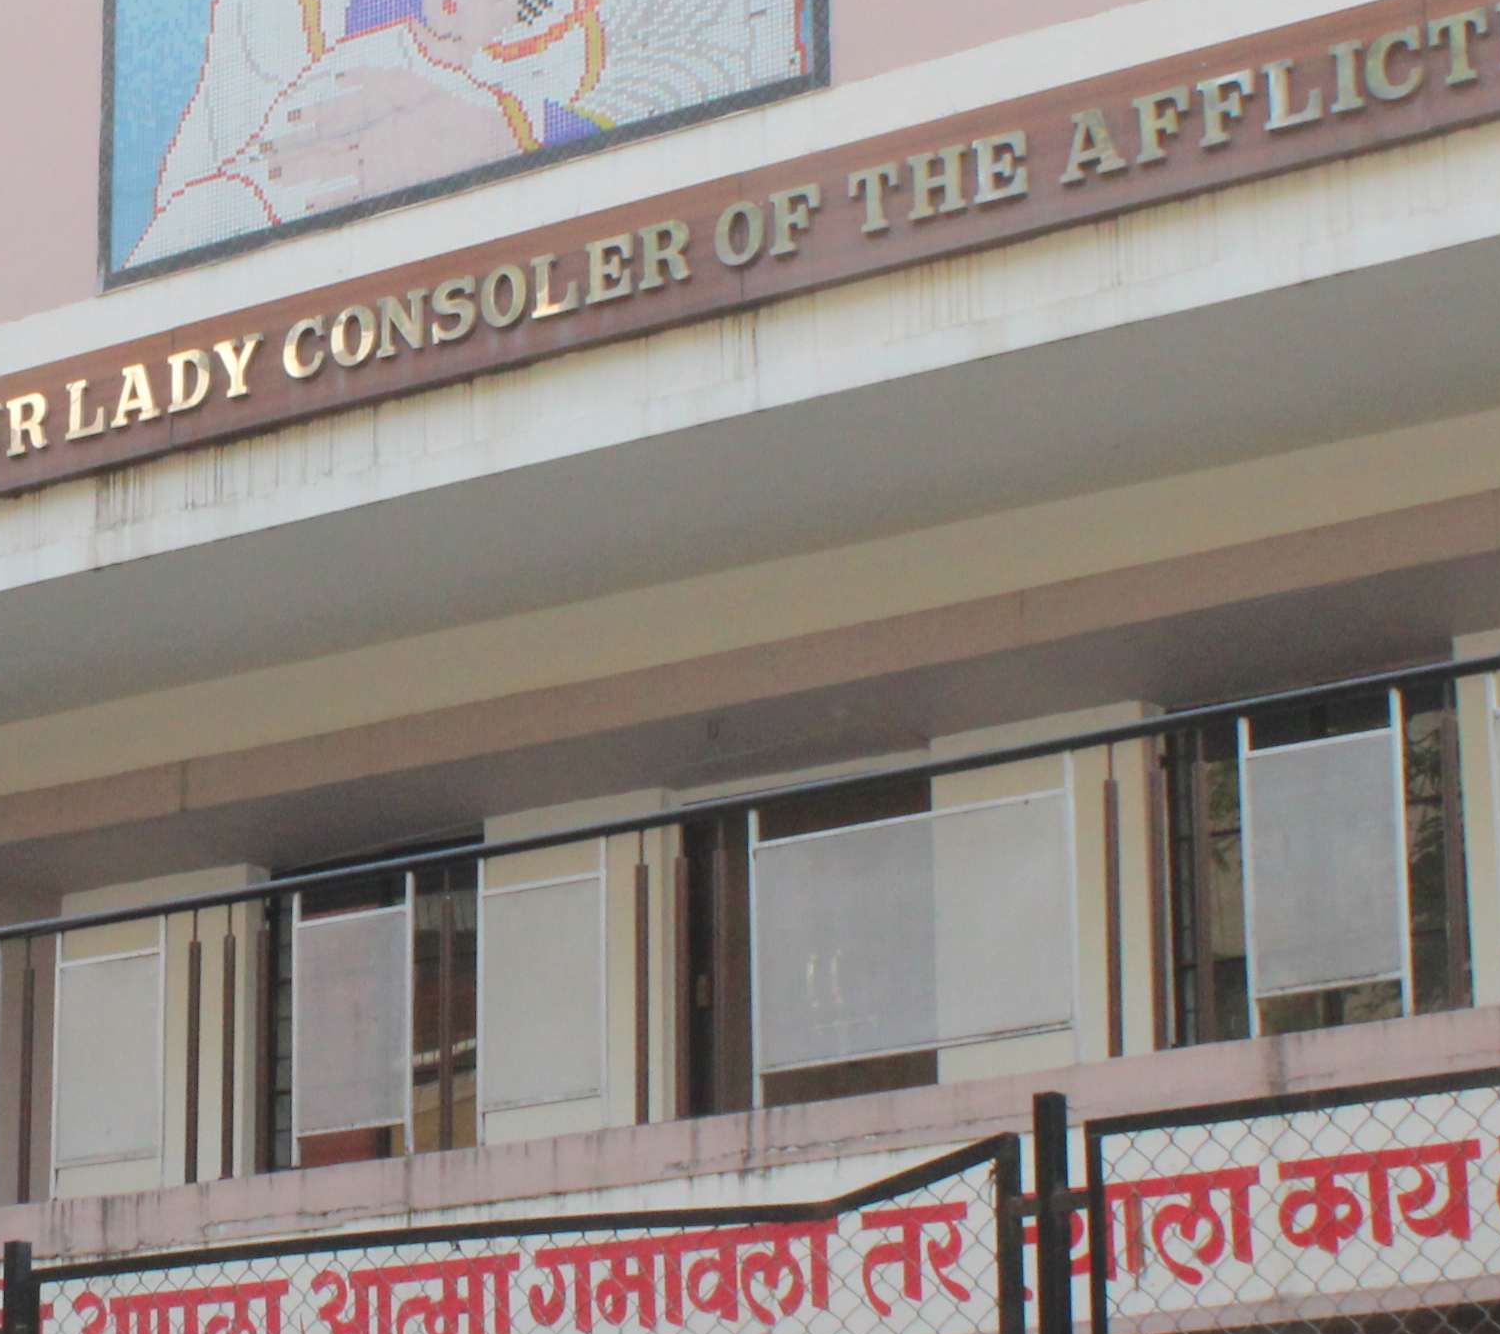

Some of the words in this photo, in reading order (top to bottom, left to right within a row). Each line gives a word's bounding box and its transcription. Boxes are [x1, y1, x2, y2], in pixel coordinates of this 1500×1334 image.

[65, 332, 264, 441] LADY
[282, 219, 692, 380] CONSOLER
[714, 183, 821, 267] OF
[848, 130, 1029, 234] THE
[862, 1202, 971, 1317] तर
[1278, 1139, 1482, 1255] काय
